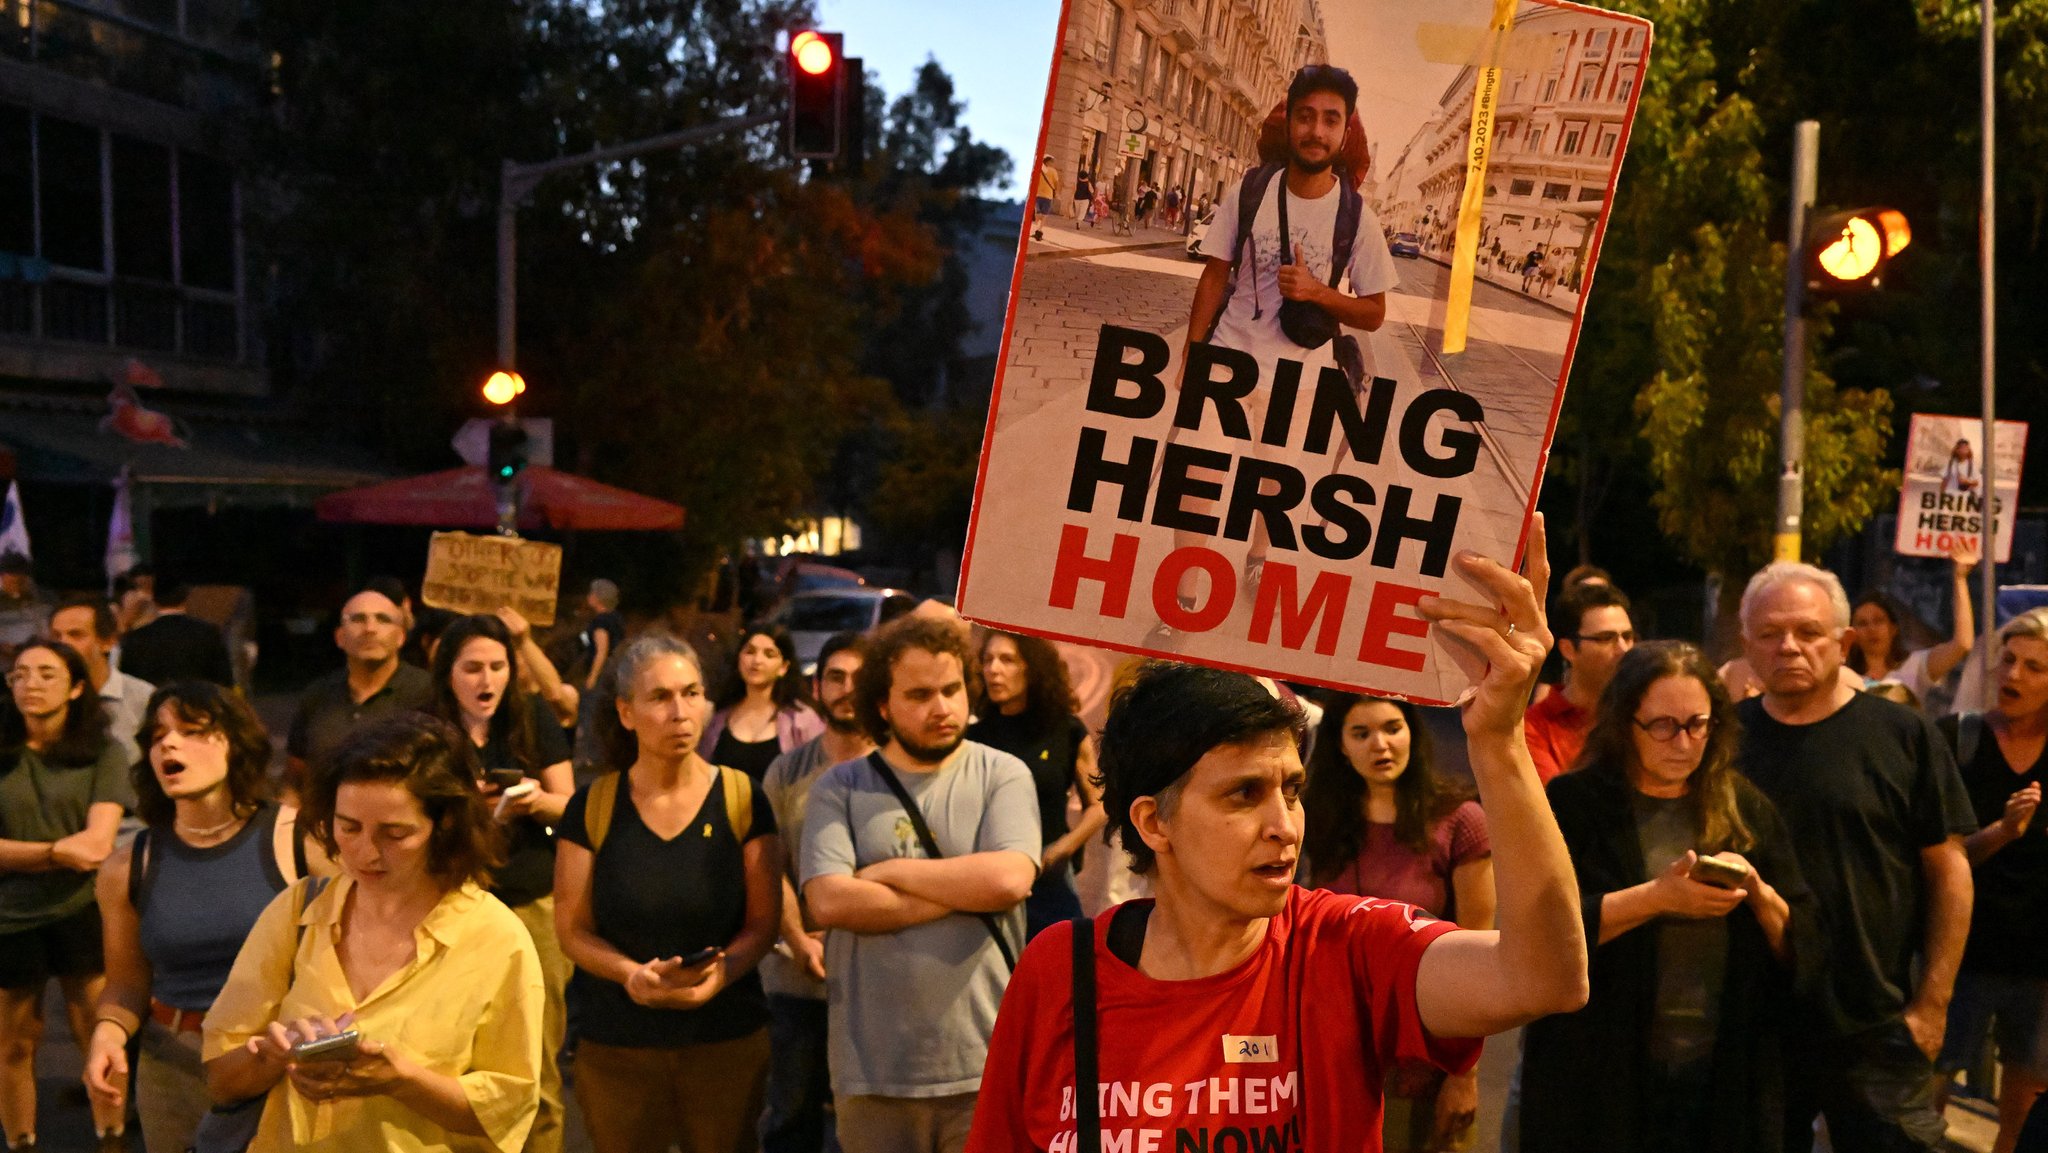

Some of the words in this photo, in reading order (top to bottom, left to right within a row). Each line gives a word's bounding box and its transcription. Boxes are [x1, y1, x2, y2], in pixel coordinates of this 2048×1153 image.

[1472, 110, 1489, 173] 7.10.2023
[1085, 324, 1485, 478] BRING
[1066, 427, 1461, 578] HERSH
[1919, 513, 1998, 535] HERS
[1048, 525, 1440, 673] HOME
[1239, 1040, 1269, 1057] 201
[1060, 1081, 1173, 1121] BING
[1184, 1071, 1298, 1115] THEM
[1049, 1128, 1163, 1153] HME
